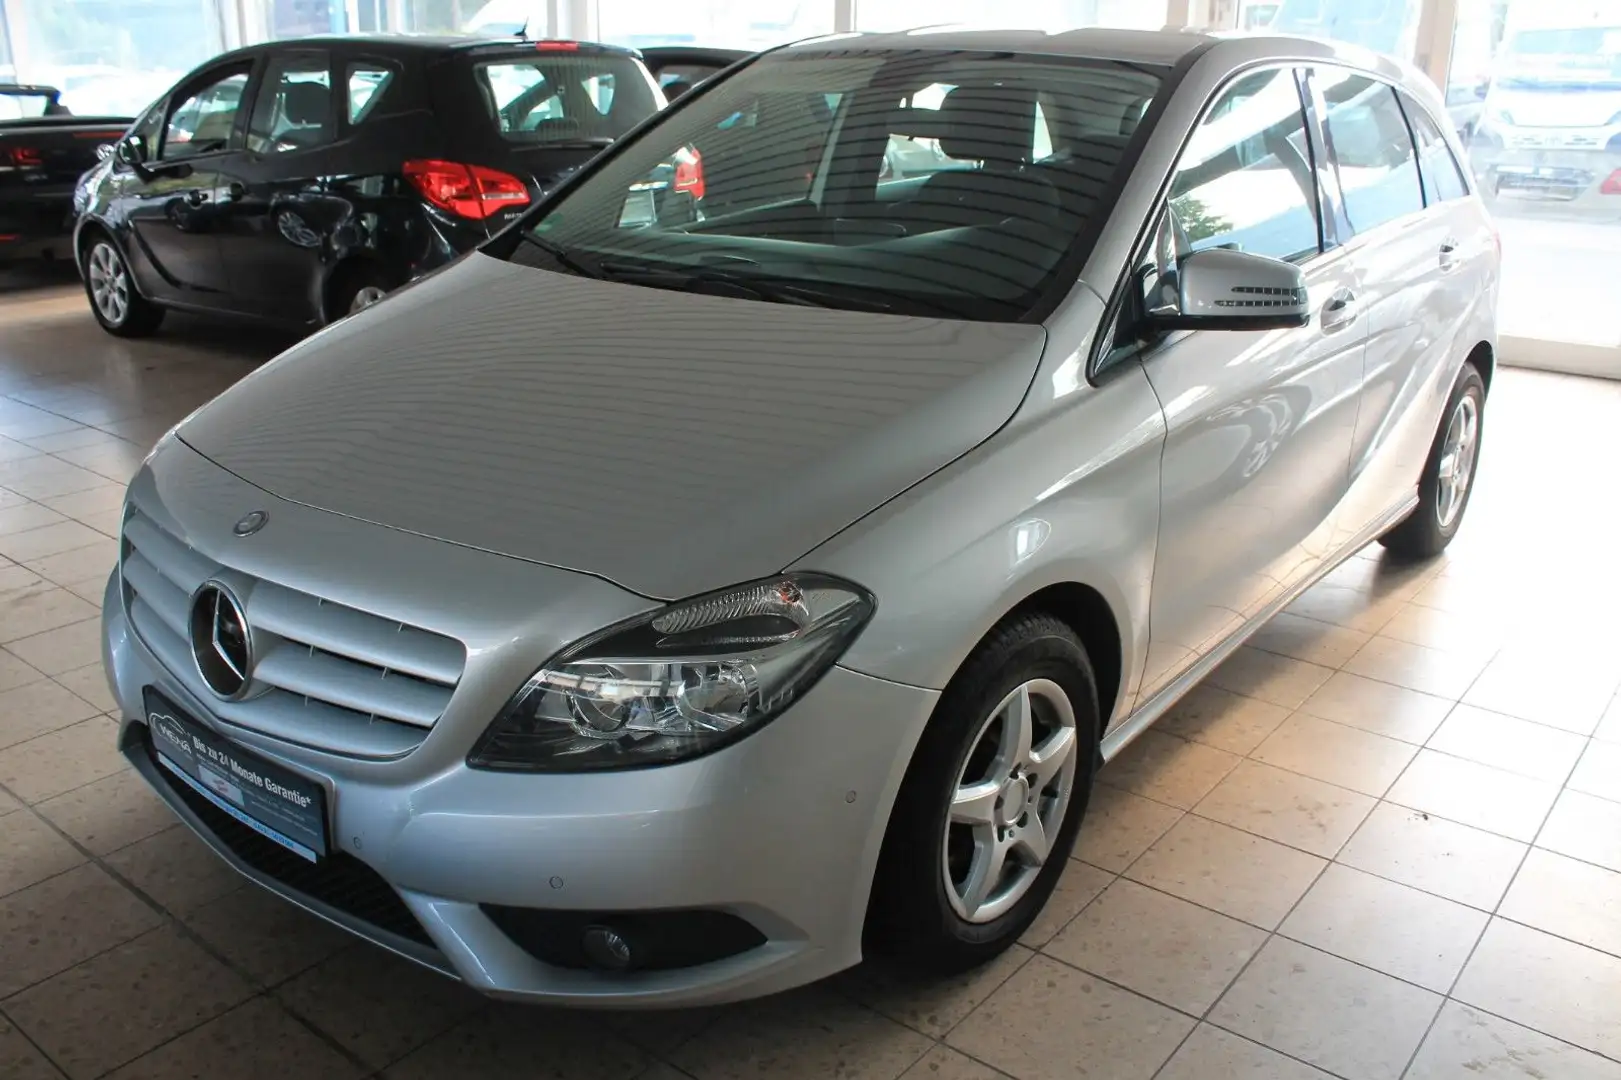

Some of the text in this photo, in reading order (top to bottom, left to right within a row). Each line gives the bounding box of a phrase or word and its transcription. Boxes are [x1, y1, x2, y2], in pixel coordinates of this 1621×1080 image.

[192, 735, 206, 754] Bis
[206, 745, 218, 761] zu
[218, 751, 229, 767] 24
[230, 758, 263, 788] Monate
